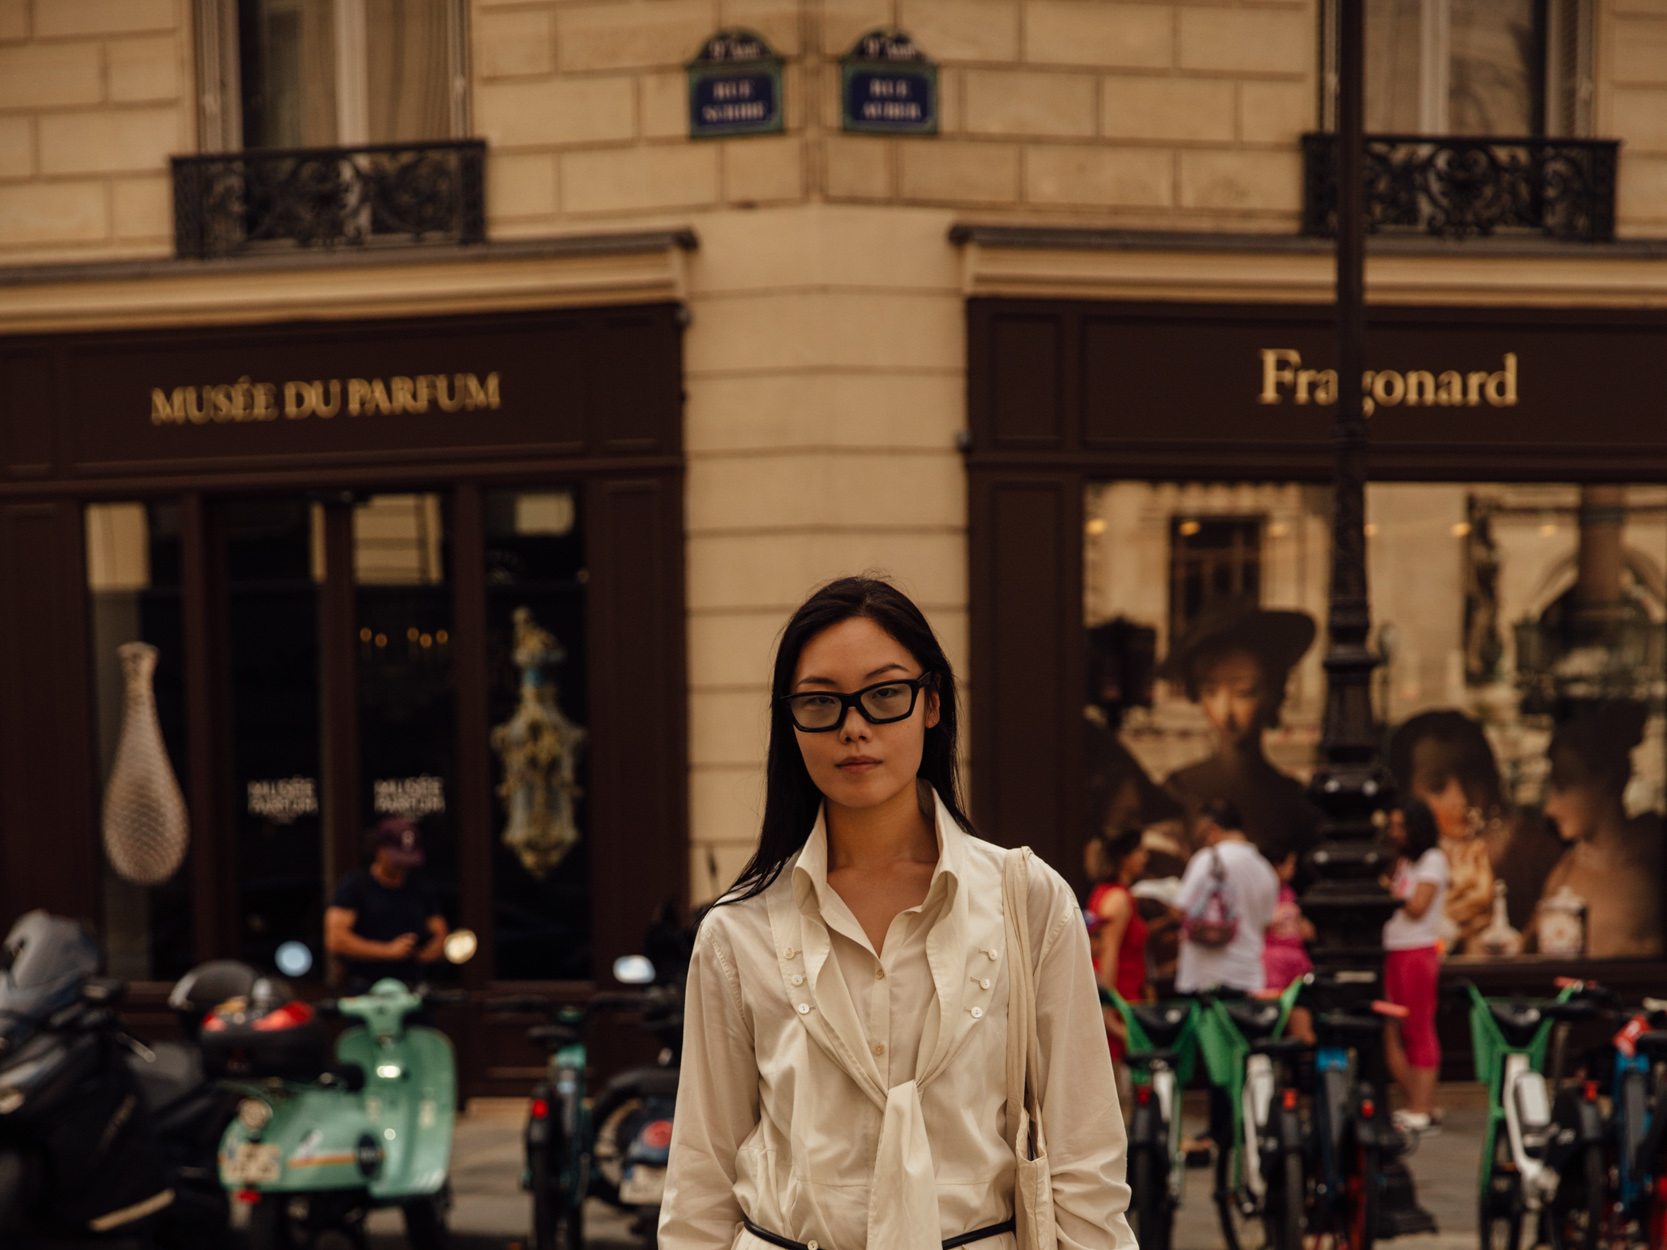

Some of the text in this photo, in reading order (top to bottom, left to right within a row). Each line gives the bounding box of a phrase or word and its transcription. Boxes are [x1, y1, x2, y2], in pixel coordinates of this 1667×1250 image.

[150, 371, 502, 425] MUSÉE DU PARFUM
